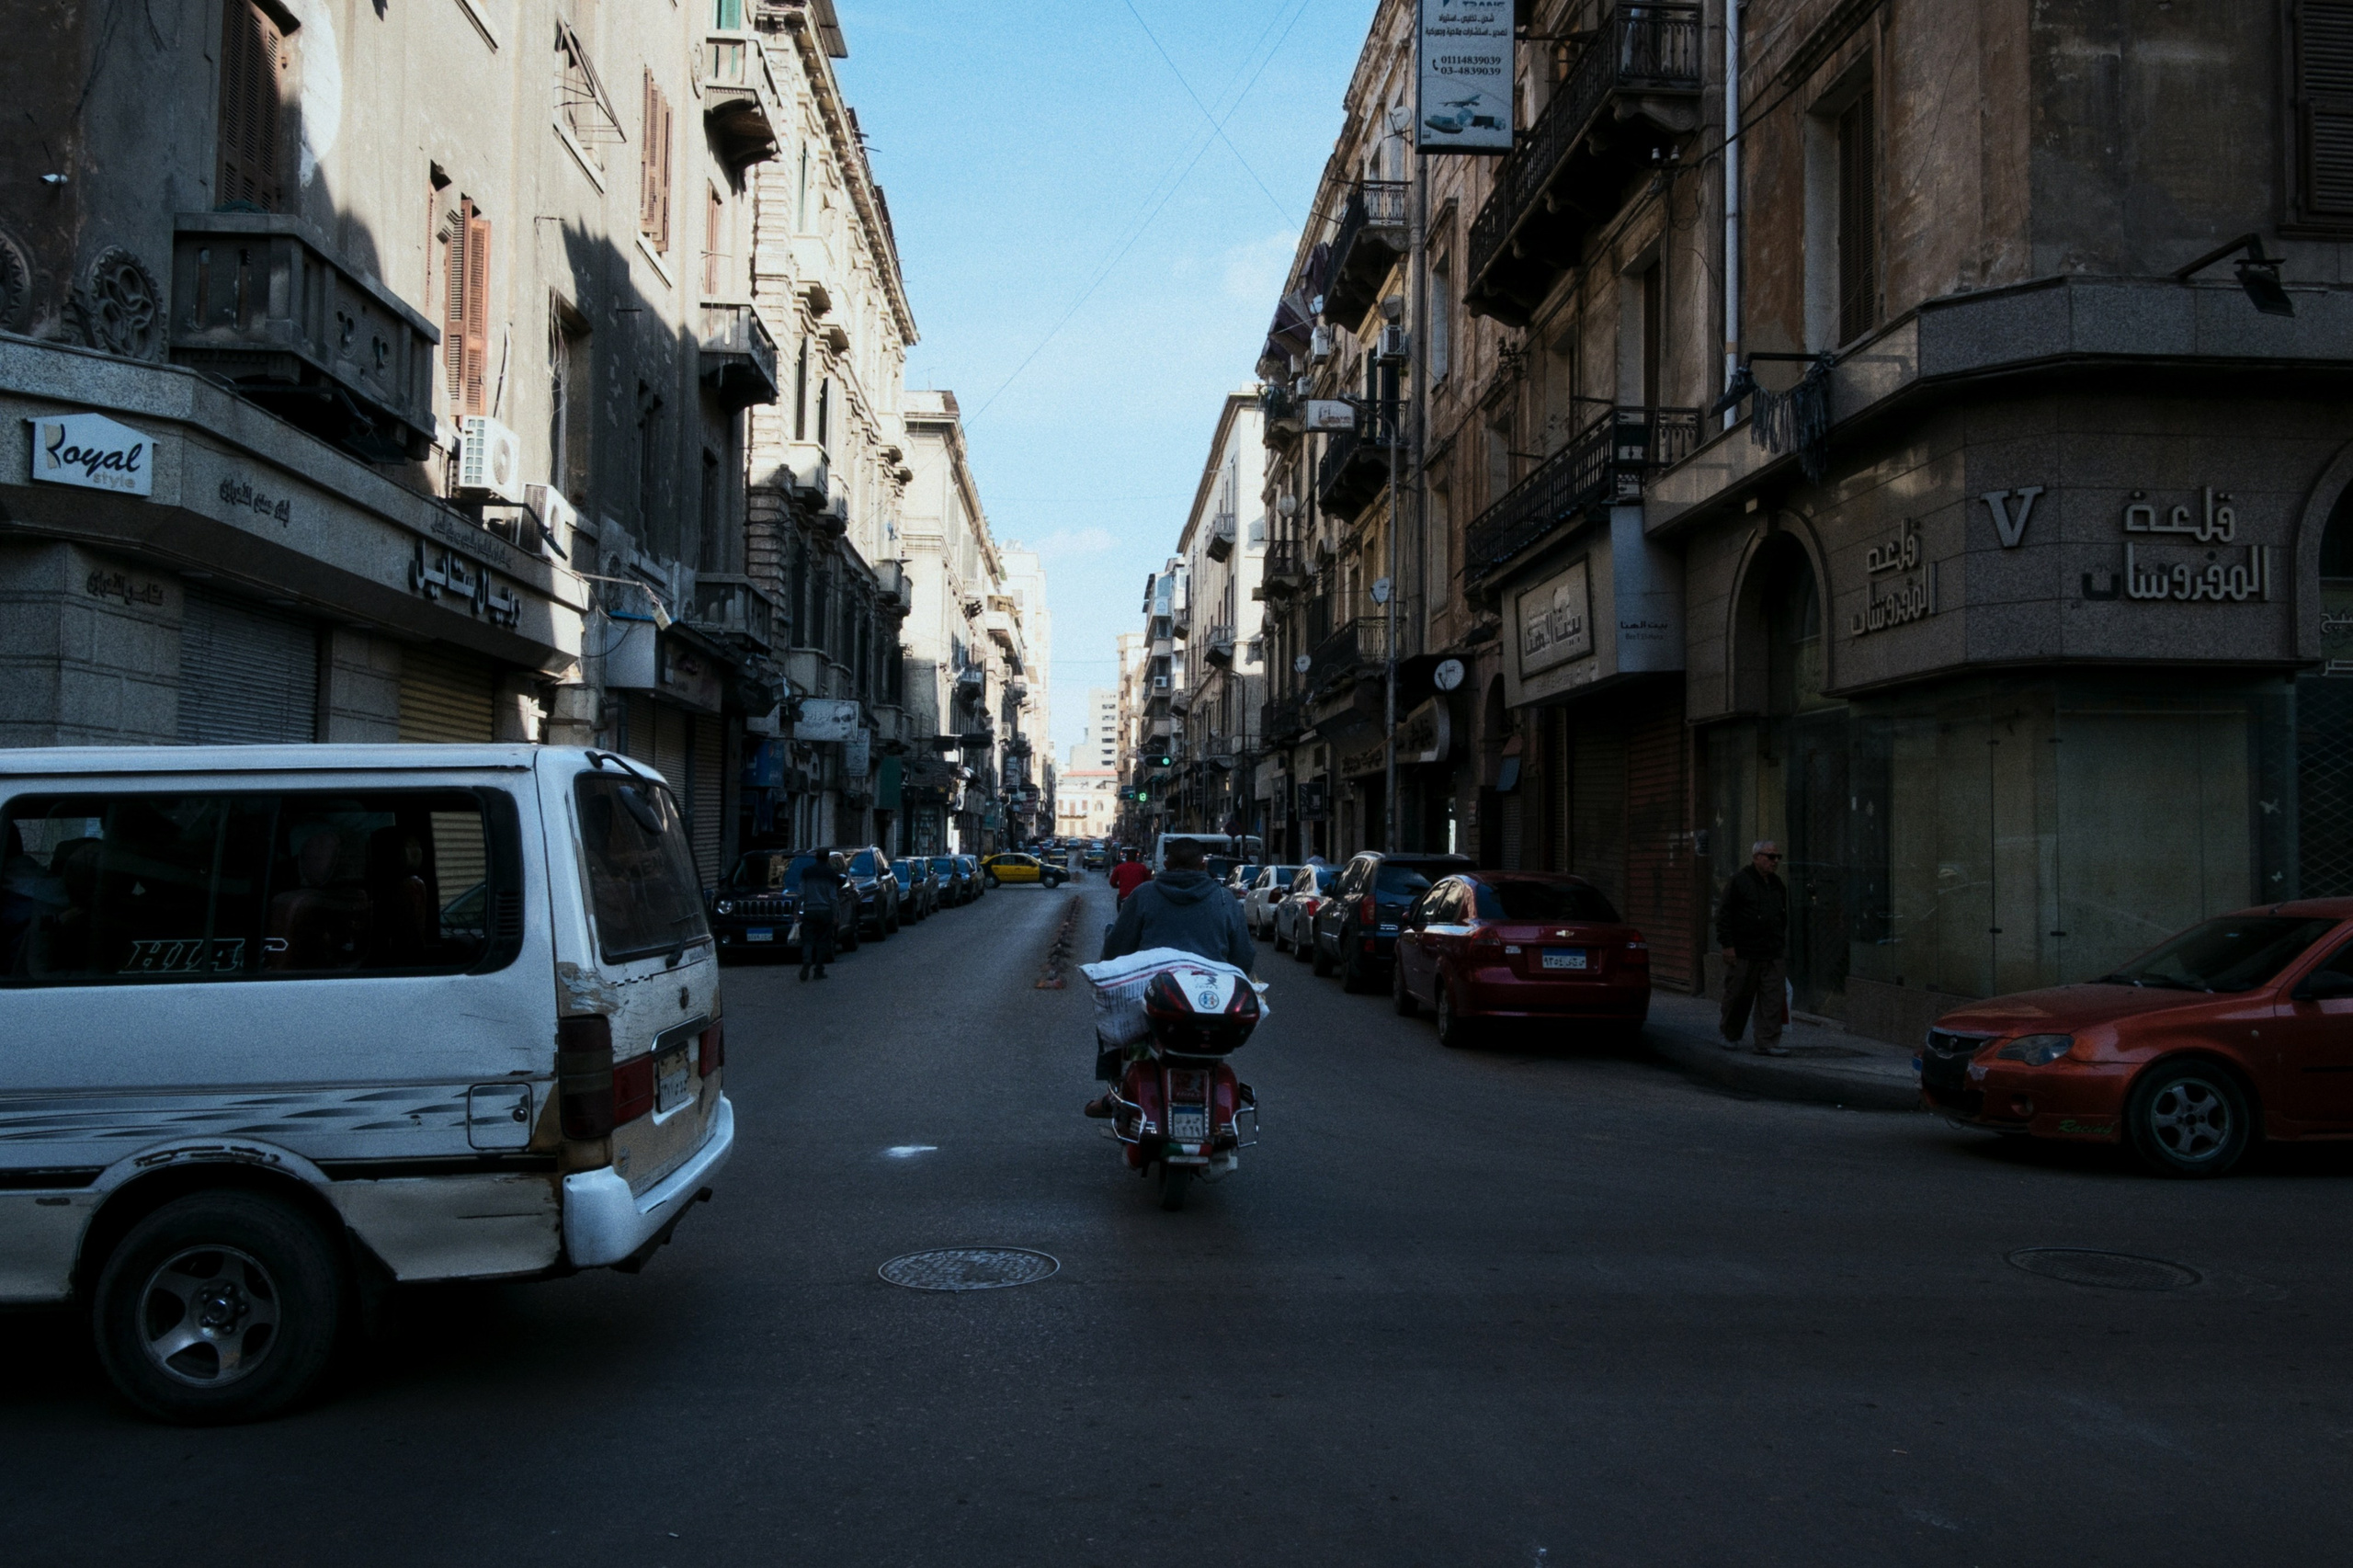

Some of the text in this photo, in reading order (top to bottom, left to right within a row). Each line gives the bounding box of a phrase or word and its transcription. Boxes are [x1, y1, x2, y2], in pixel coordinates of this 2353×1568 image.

[1440, 56, 1501, 65] 01114839039
[1440, 67, 1501, 75] 03-4839039
[44, 424, 142, 478] Royal
[93, 472, 136, 489] style
[1979, 487, 2045, 549] V
[2058, 1119, 2116, 1136] Racing
